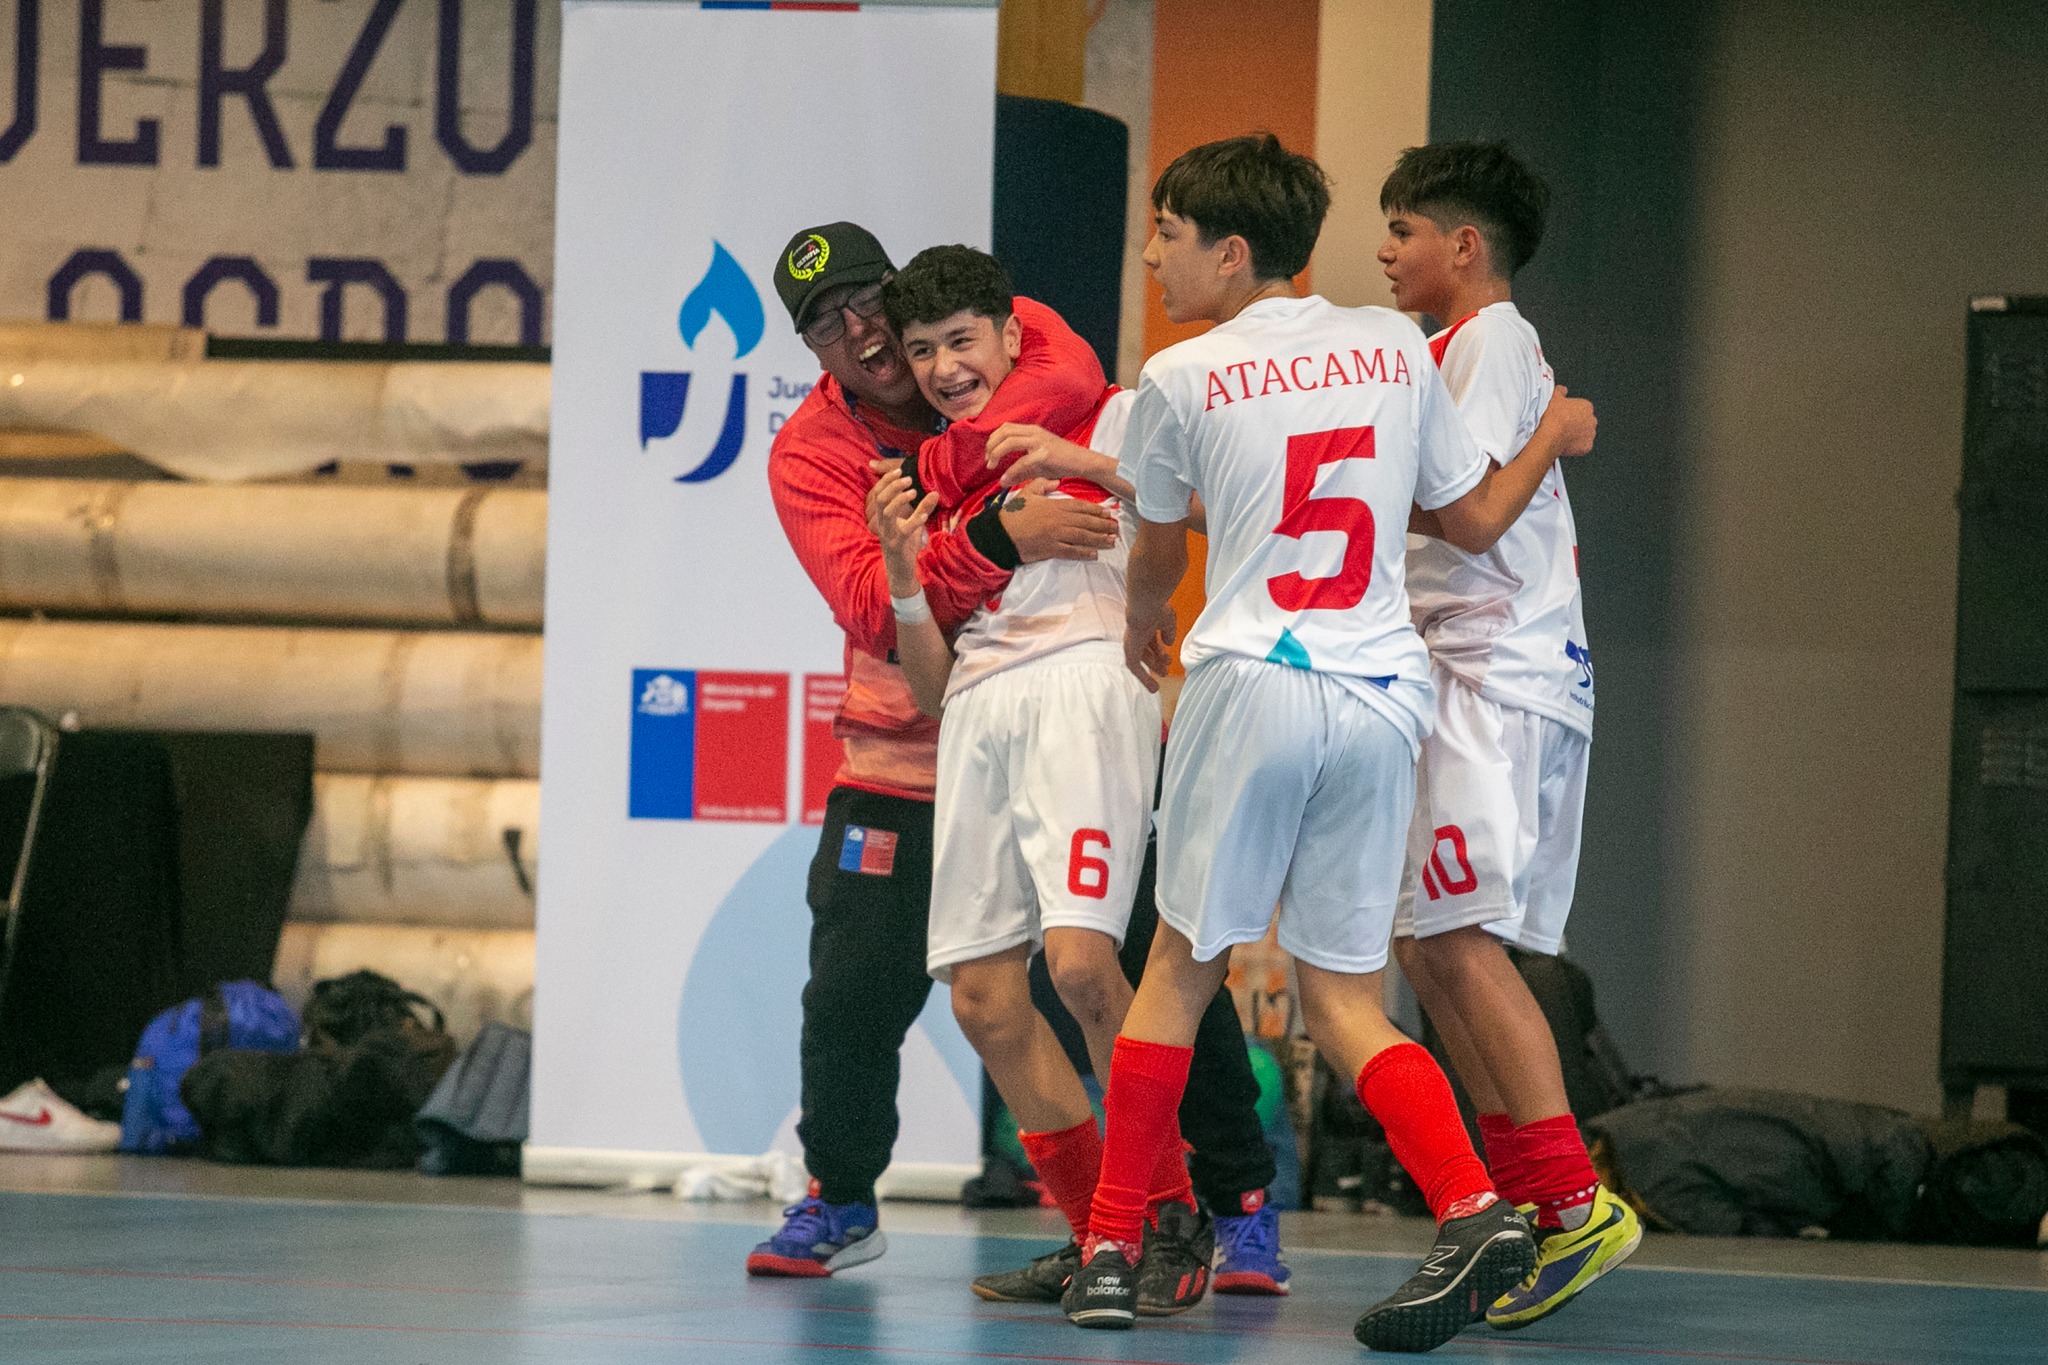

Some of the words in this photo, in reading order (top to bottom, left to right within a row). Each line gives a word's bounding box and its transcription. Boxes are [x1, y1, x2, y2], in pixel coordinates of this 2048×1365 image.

[1204, 348, 1412, 412] ATACAMA
[1266, 425, 1376, 612] 5
[1067, 827, 1112, 900] 6
[1422, 824, 1478, 901] 10
[1087, 1285, 1130, 1296] balance
[1097, 1276, 1120, 1286] new
